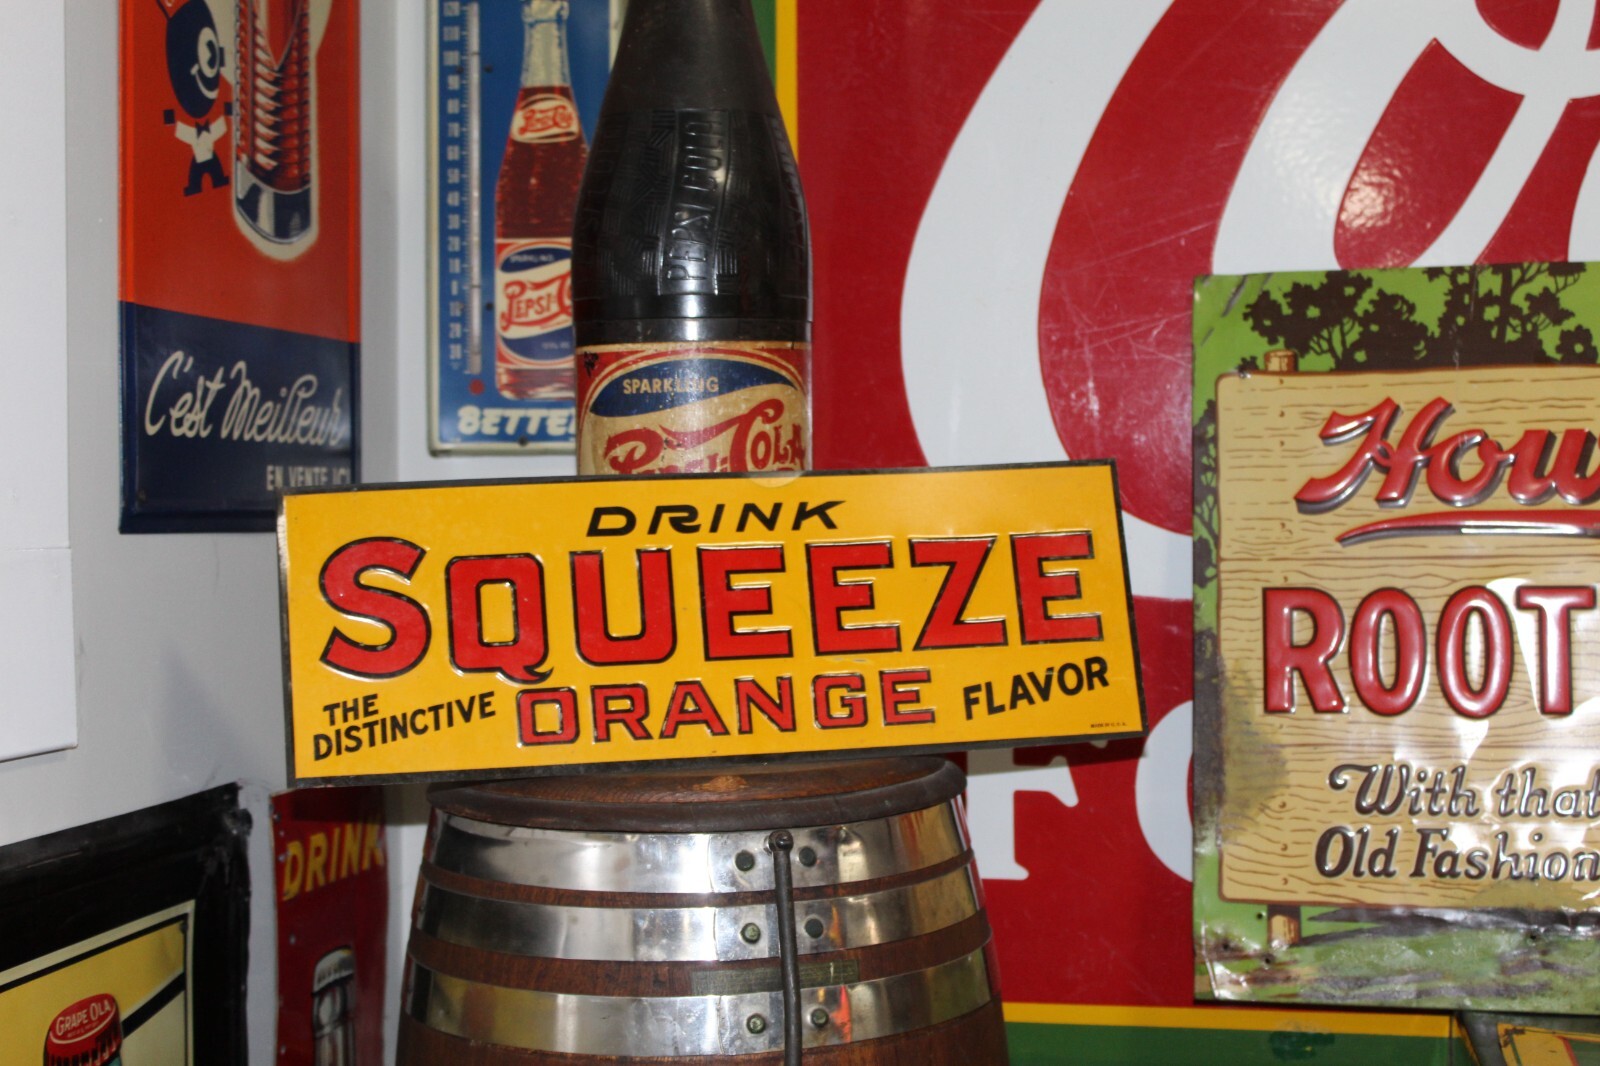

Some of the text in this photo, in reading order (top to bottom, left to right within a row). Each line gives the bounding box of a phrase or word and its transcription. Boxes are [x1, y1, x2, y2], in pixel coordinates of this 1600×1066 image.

[144, 350, 349, 446] C'est Meilleur
[622, 376, 719, 395] SPARKLING
[456, 404, 576, 436] BETTE
[266, 465, 284, 491] EN
[586, 499, 847, 538] DRINK
[318, 530, 1104, 685] SQUEEZE
[1262, 584, 1597, 718] ROOT
[322, 693, 379, 727] THE
[516, 668, 936, 747] ORANGE
[963, 656, 1110, 721] FLAVOR
[313, 690, 496, 762] DISTINCTIVE
[1327, 764, 1600, 819] With that
[282, 818, 386, 902] DRINK
[1314, 825, 1600, 882] Old Fashion
[55, 1008, 89, 1036] GRAPE
[89, 999, 112, 1021] OLA
